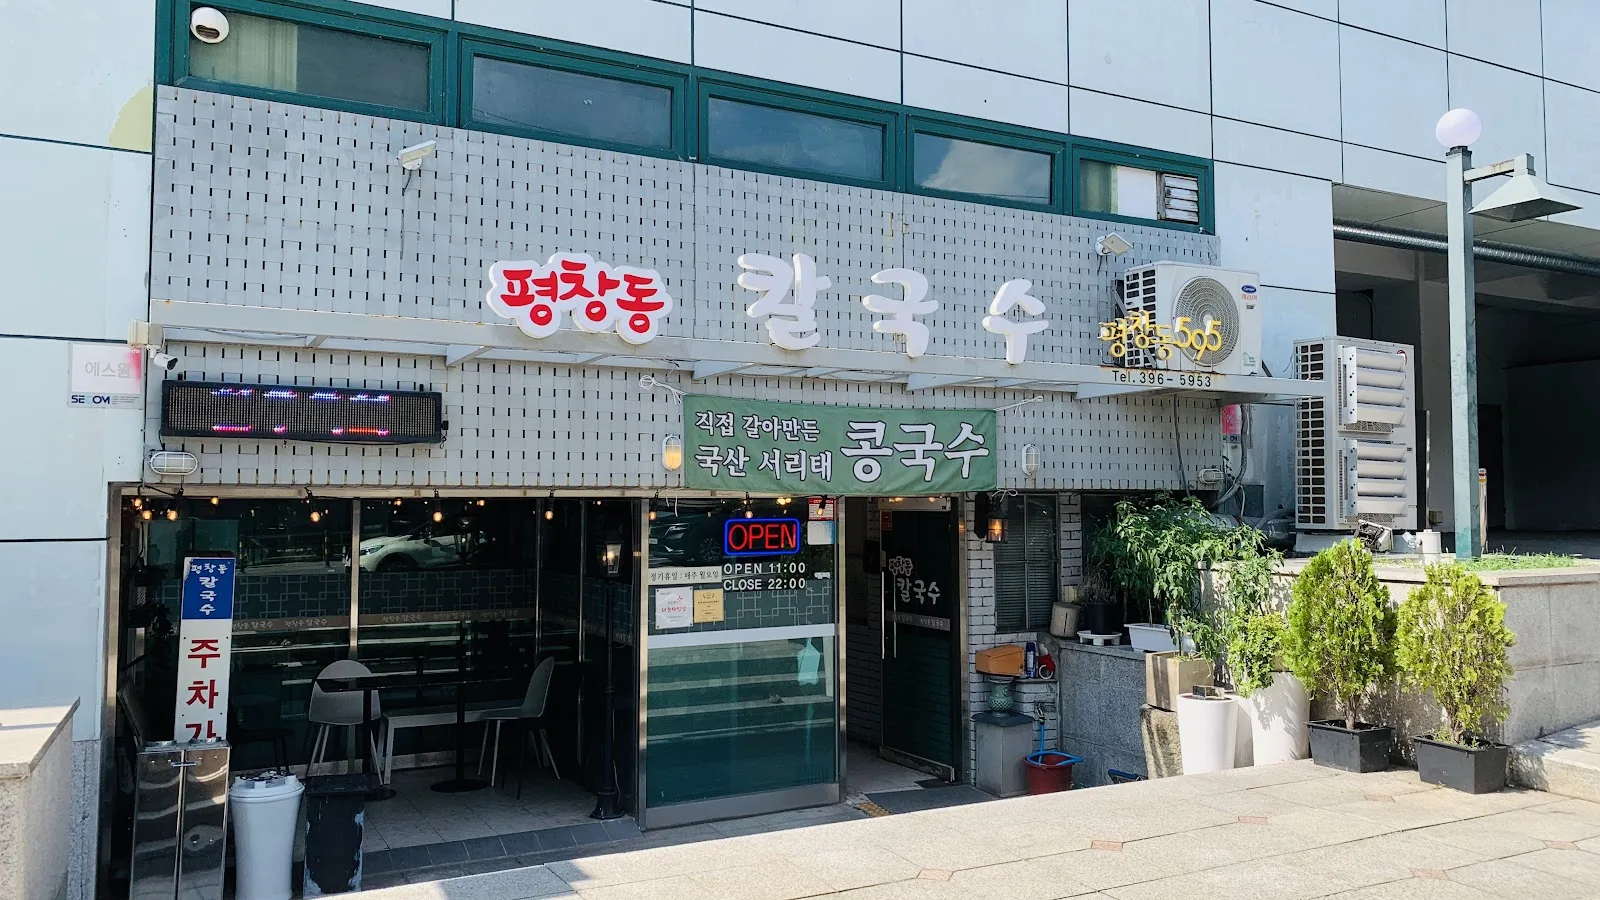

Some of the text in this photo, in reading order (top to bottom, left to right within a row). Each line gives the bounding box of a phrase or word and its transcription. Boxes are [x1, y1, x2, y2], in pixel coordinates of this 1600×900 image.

[500, 259, 665, 334] 평창동
[695, 410, 820, 441] 직접 갈아만든
[694, 445, 833, 482] 국산 서리태
[840, 420, 989, 483] 콩국수
[728, 523, 797, 551] OPEN
[190, 562, 228, 575] 평창동
[699, 570, 719, 580] 월요일
[723, 562, 806, 575] OPEN 11:00
[198, 575, 219, 616] 칼국수
[723, 577, 806, 591] CLOSE 22:00
[896, 577, 941, 605] 칼국수
